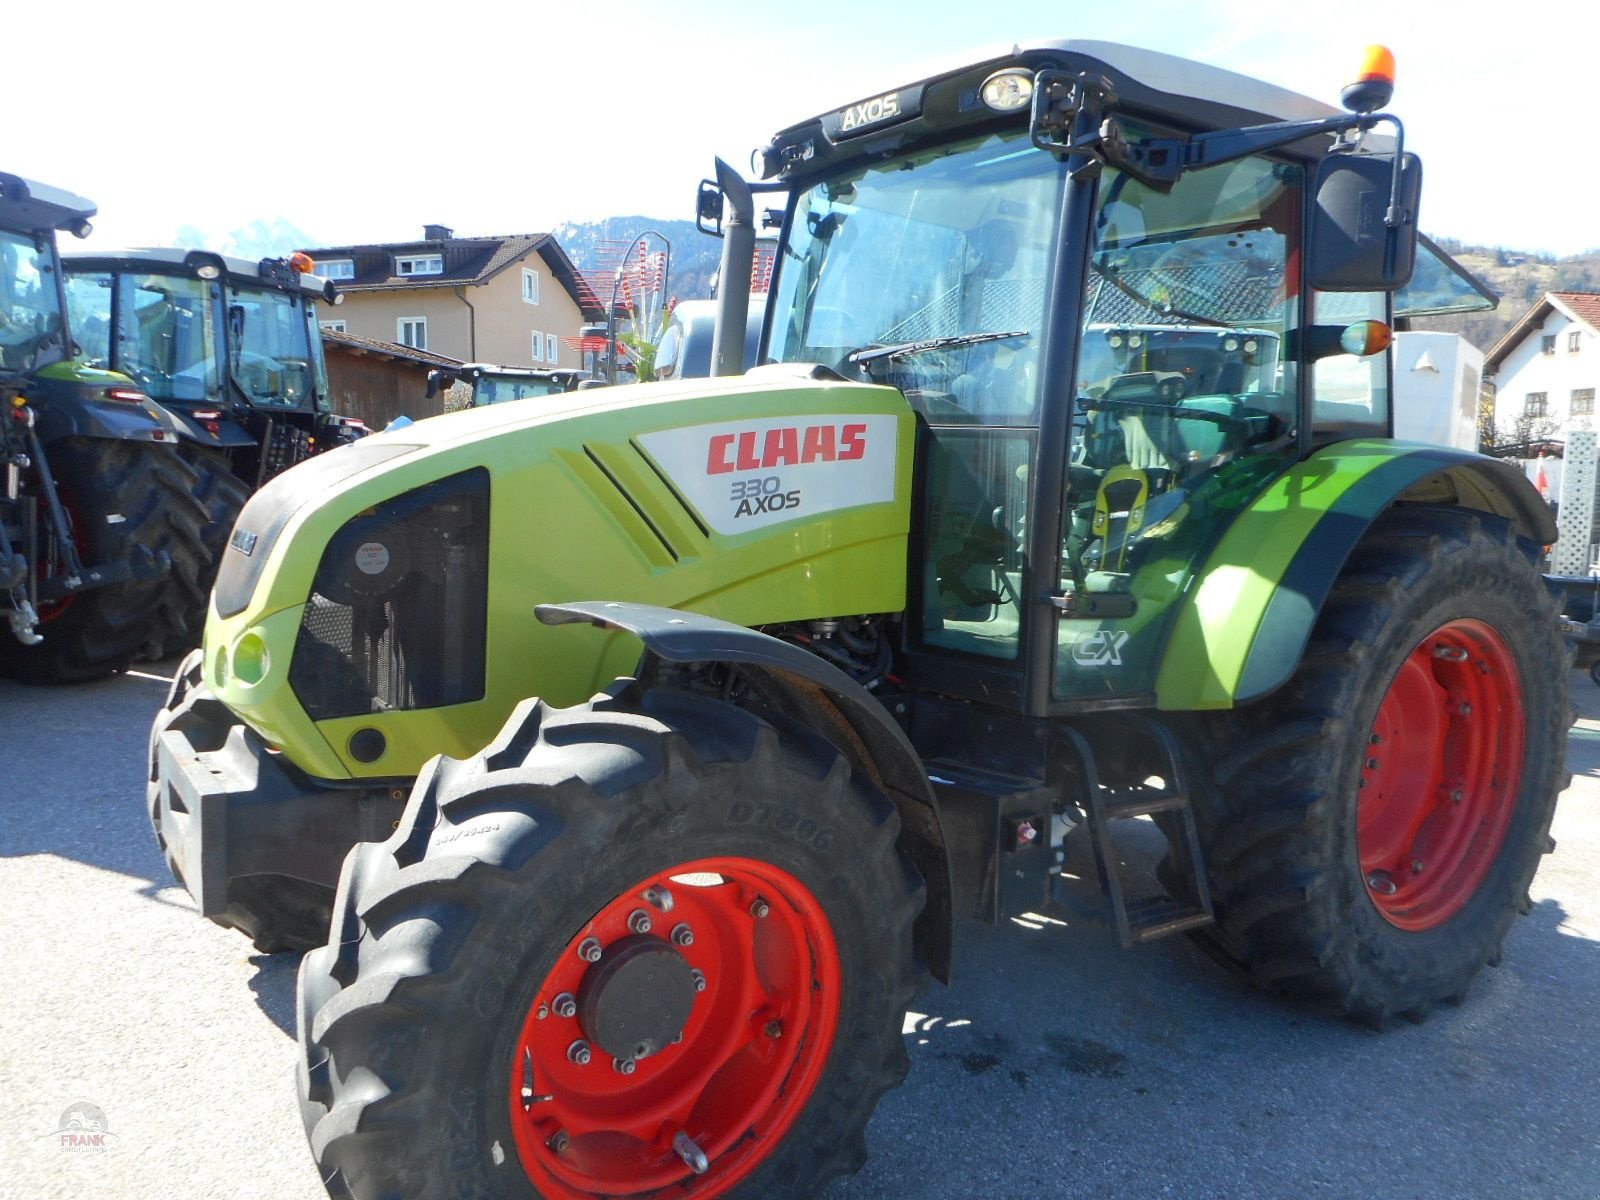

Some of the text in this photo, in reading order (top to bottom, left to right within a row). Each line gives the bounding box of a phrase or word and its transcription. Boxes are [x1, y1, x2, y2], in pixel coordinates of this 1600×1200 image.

[841, 93, 899, 132] AXOS
[706, 423, 867, 475] CLAAS
[730, 475, 781, 501] 330
[734, 489, 801, 519] AXOS
[1072, 630, 1130, 666] CX
